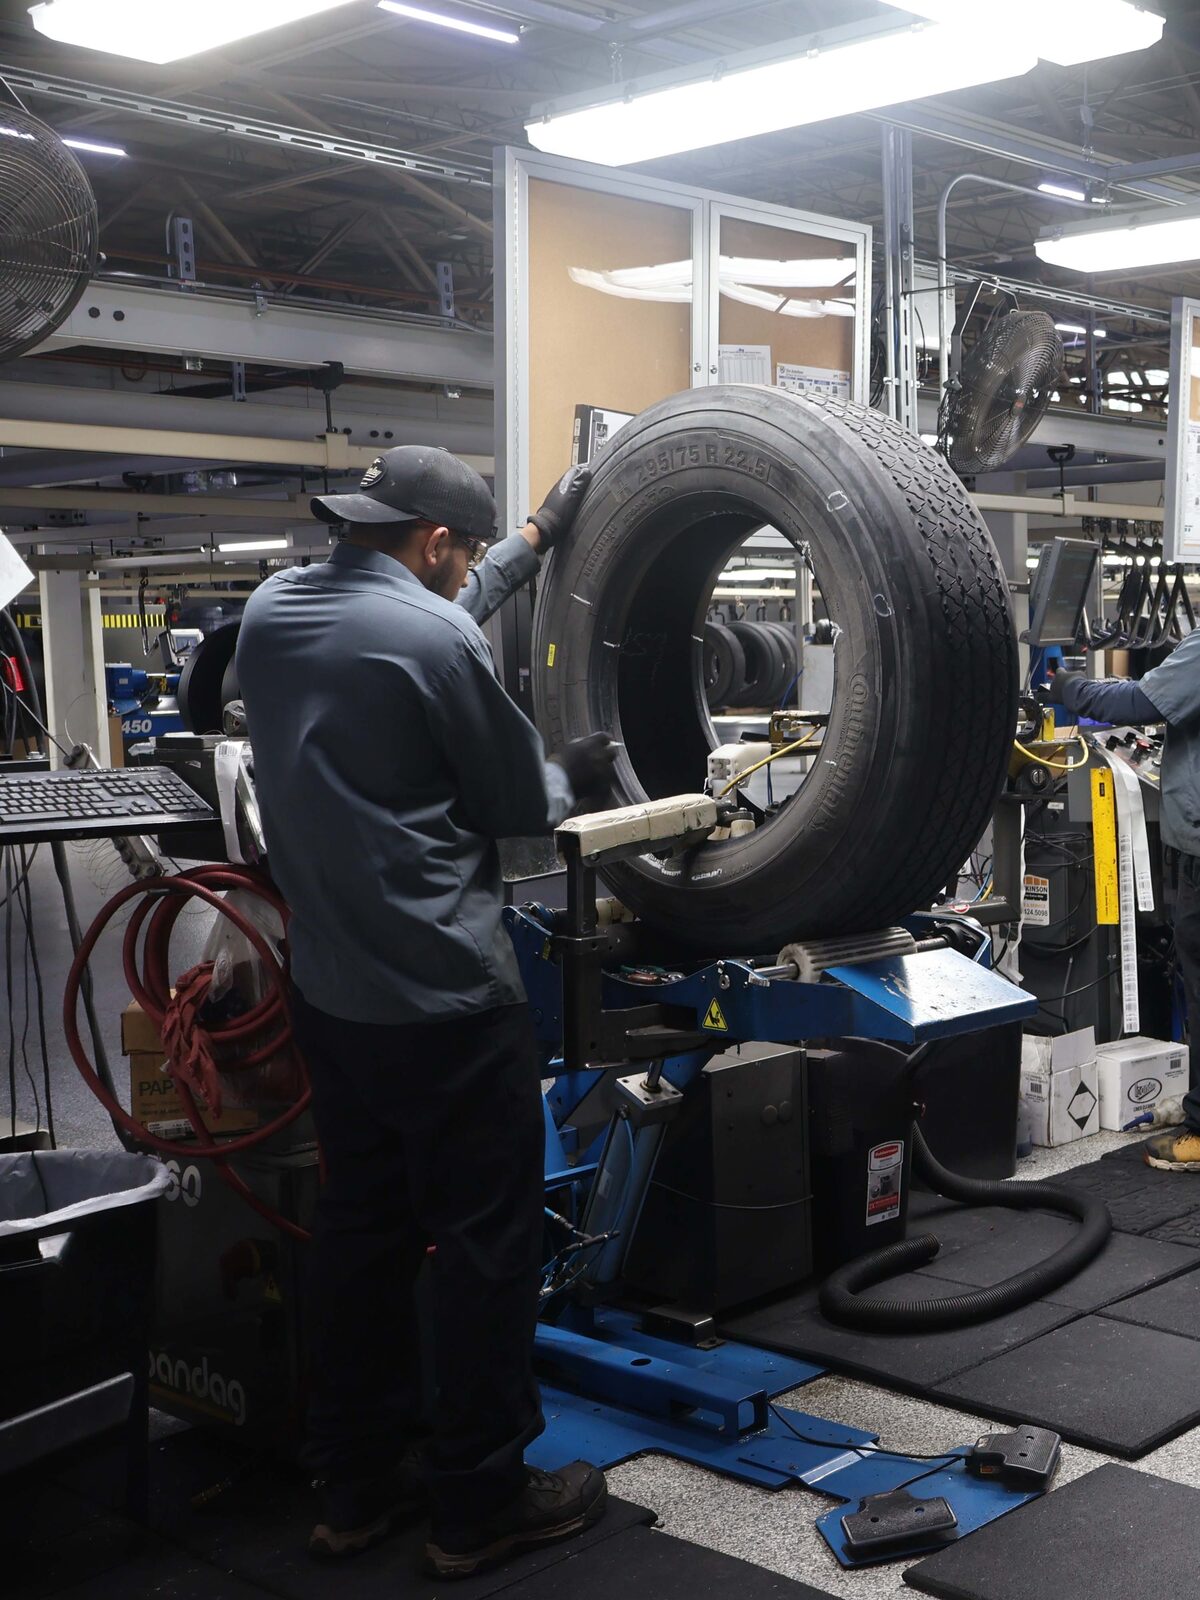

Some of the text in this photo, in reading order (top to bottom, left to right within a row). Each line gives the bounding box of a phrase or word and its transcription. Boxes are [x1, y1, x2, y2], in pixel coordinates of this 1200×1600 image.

[705, 443, 720, 464] R
[724, 446, 767, 480] 22.5
[819, 672, 869, 820] Continental
[139, 1079, 178, 1097] PAP
